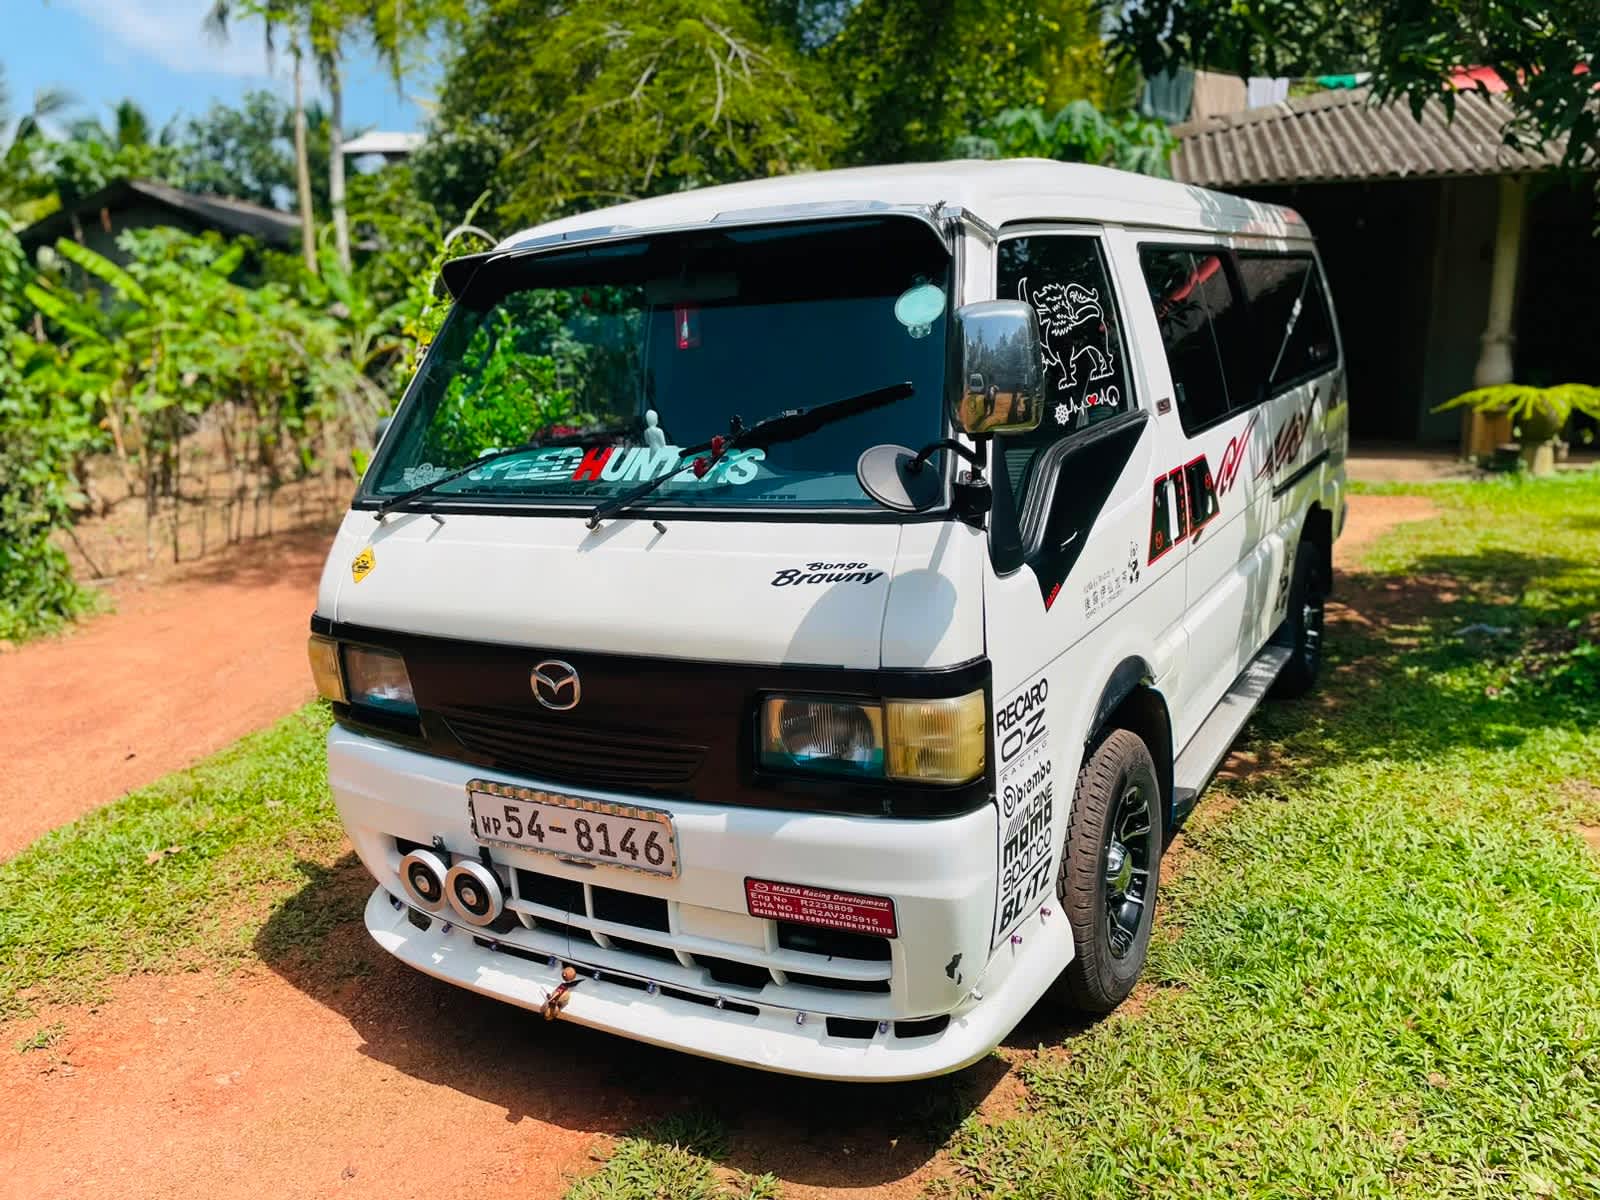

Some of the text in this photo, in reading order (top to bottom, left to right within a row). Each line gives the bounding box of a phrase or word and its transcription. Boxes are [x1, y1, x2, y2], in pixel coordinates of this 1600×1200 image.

[771, 569, 884, 587] Brawny
[806, 561, 869, 571] Bongo
[996, 678, 1048, 737] RECARO
[1002, 739, 1047, 783] RACING
[1015, 760, 1052, 804] brembo
[504, 804, 665, 866] 54-8146
[1003, 798, 1053, 870] momo
[1002, 827, 1052, 896] sparco
[751, 892, 771, 902] Eng
[773, 894, 788, 903] No
[751, 900, 775, 909] CHA
[753, 907, 778, 917] MAZDA
[780, 911, 804, 921] MOTOR
[772, 884, 889, 908] MAZDA Racing Development
[998, 855, 1053, 936] BLITZ
